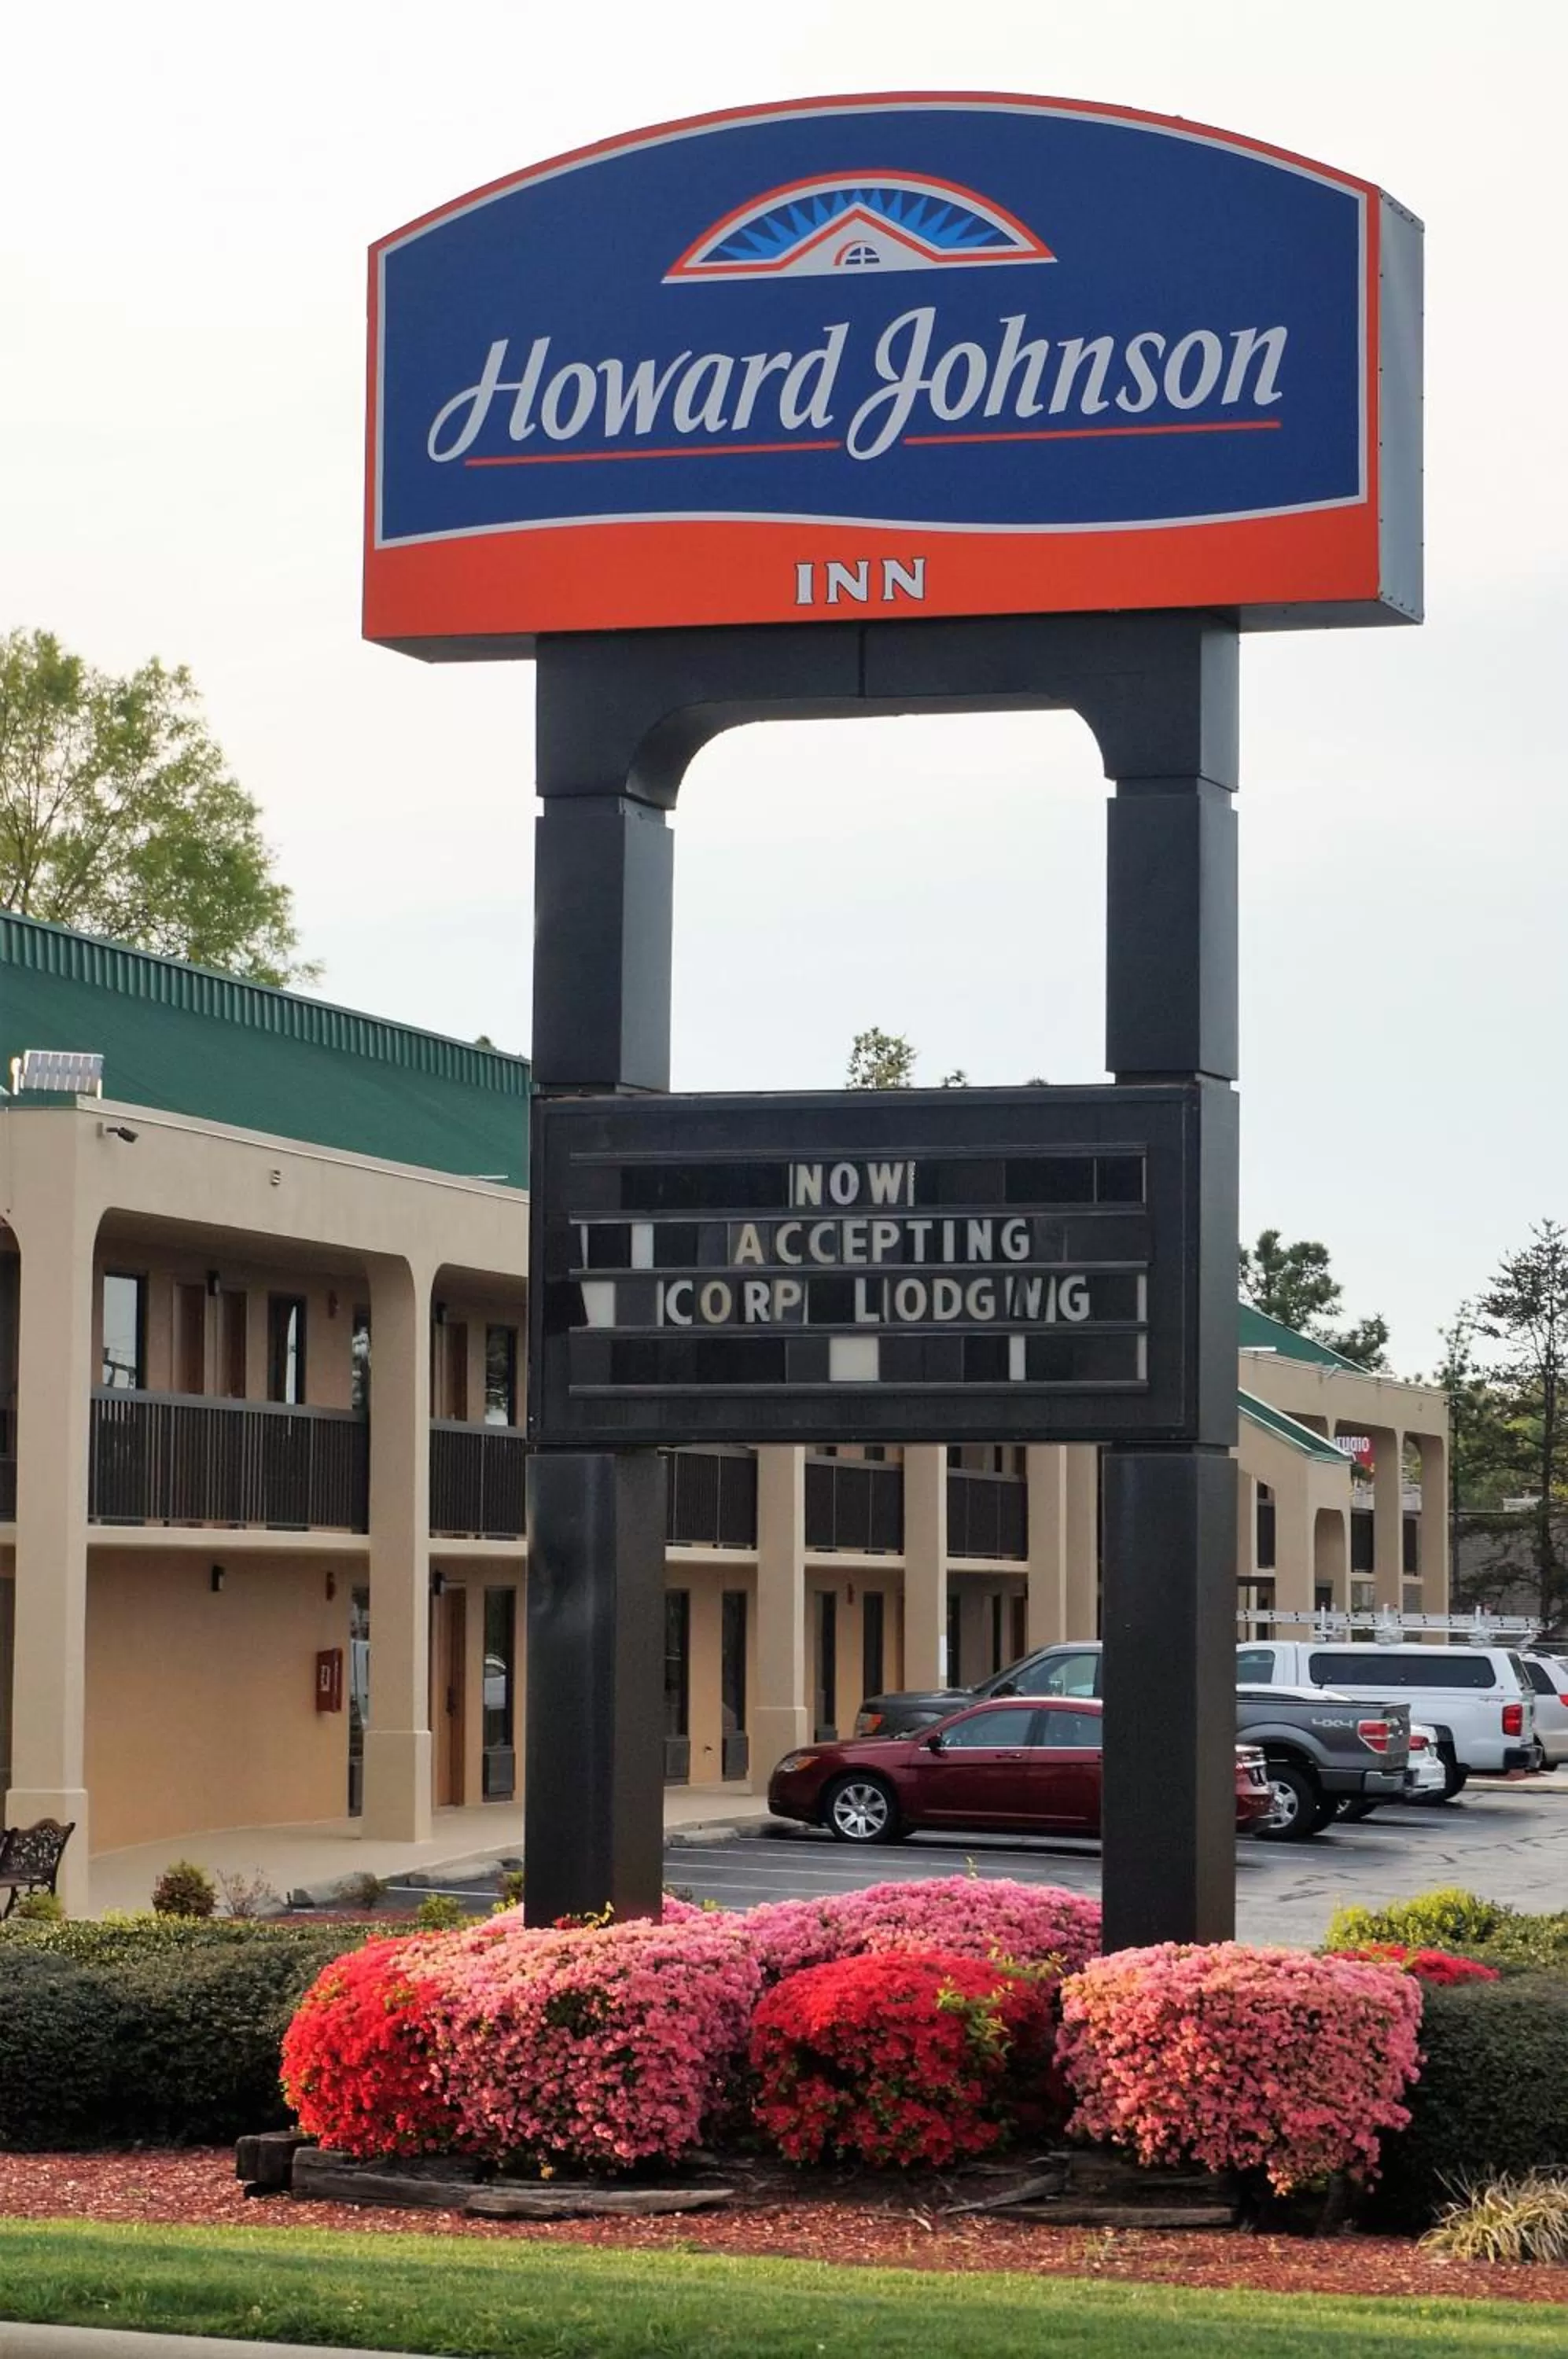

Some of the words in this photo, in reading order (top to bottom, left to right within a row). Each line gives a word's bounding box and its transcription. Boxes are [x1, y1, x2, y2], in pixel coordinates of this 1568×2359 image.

[427, 321, 850, 462] Howard
[846, 306, 1288, 461] Johnson
[794, 557, 926, 606] INN
[795, 1161, 904, 1206] NOW
[734, 1219, 1030, 1265] ACCEPTING
[665, 1279, 802, 1325] CORP
